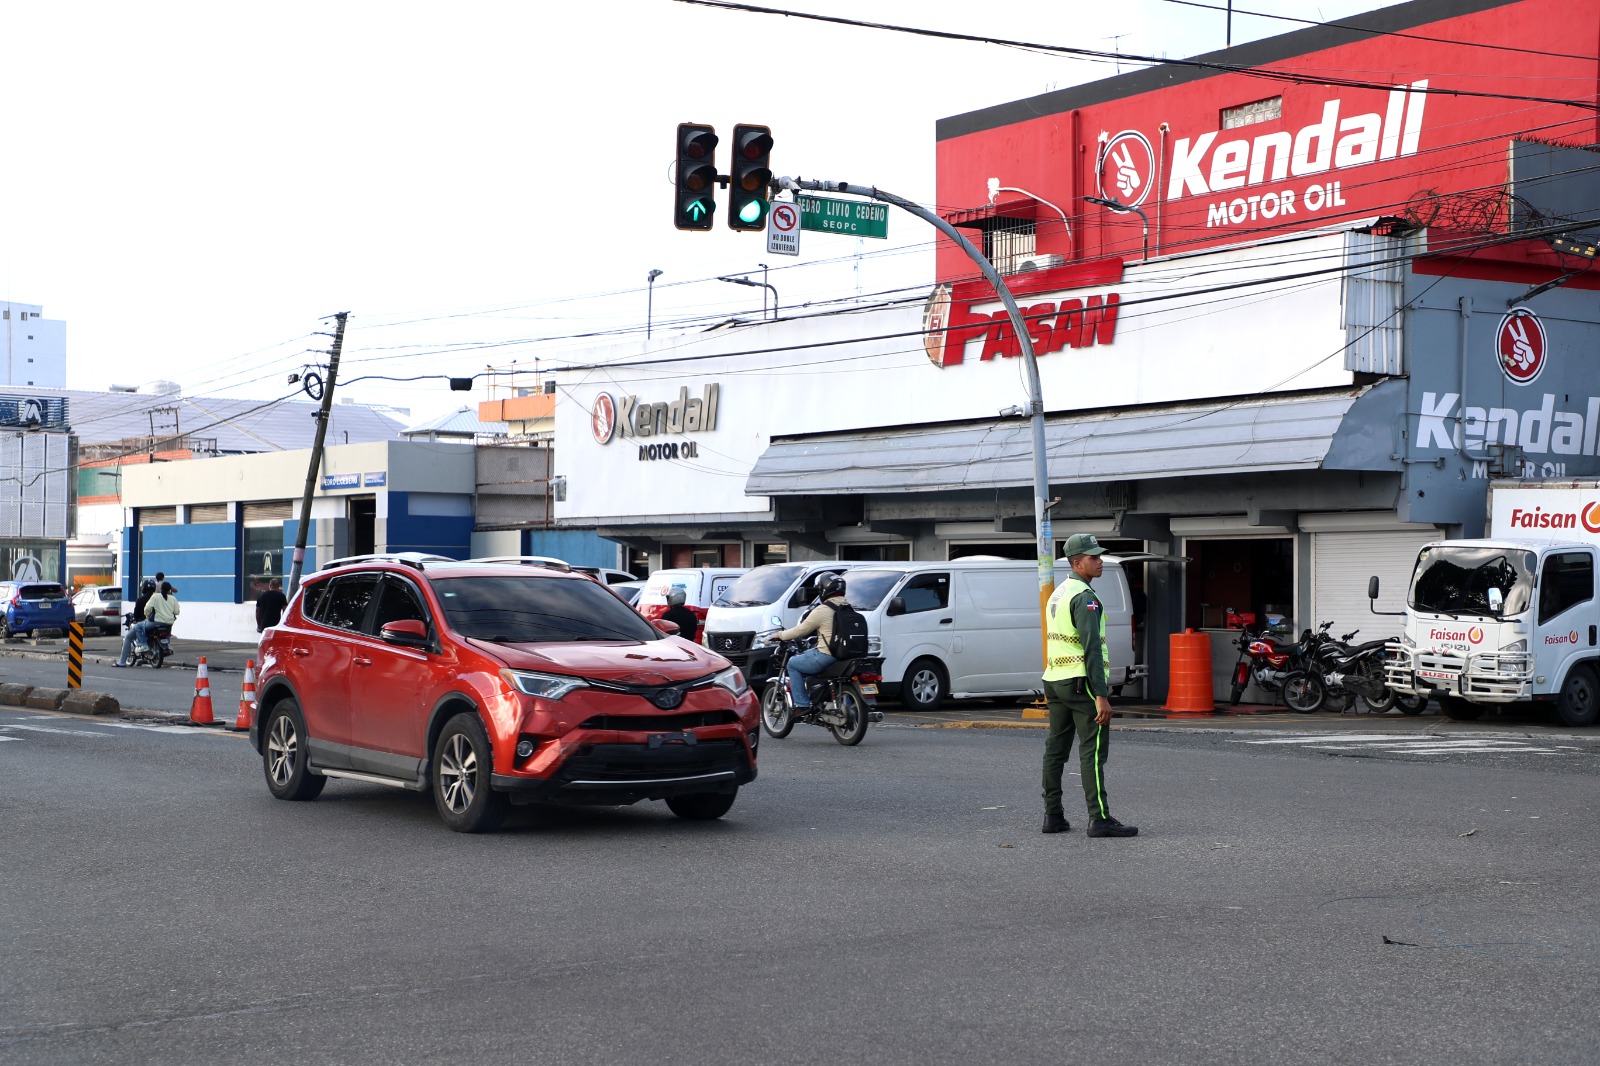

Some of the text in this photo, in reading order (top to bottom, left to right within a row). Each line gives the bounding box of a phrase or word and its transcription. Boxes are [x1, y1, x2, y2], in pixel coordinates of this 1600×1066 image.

[1167, 79, 1428, 200] Kendall
[826, 202, 850, 218] LIVIO
[1207, 181, 1345, 228] MOTOR OIL
[823, 220, 857, 231] SEOPC
[772, 233, 795, 243] NO DOBLE
[770, 243, 796, 252] IZQUIERDA
[616, 383, 720, 438] Kendall
[1416, 391, 1600, 456] Kendal
[639, 441, 699, 461] MOTOR OIL
[1511, 506, 1577, 528] Faisan
[1430, 627, 1466, 641] Faisan
[1544, 633, 1568, 645] Faisan
[1441, 643, 1470, 652] ISUZU
[1416, 670, 1454, 679] ISUZU
